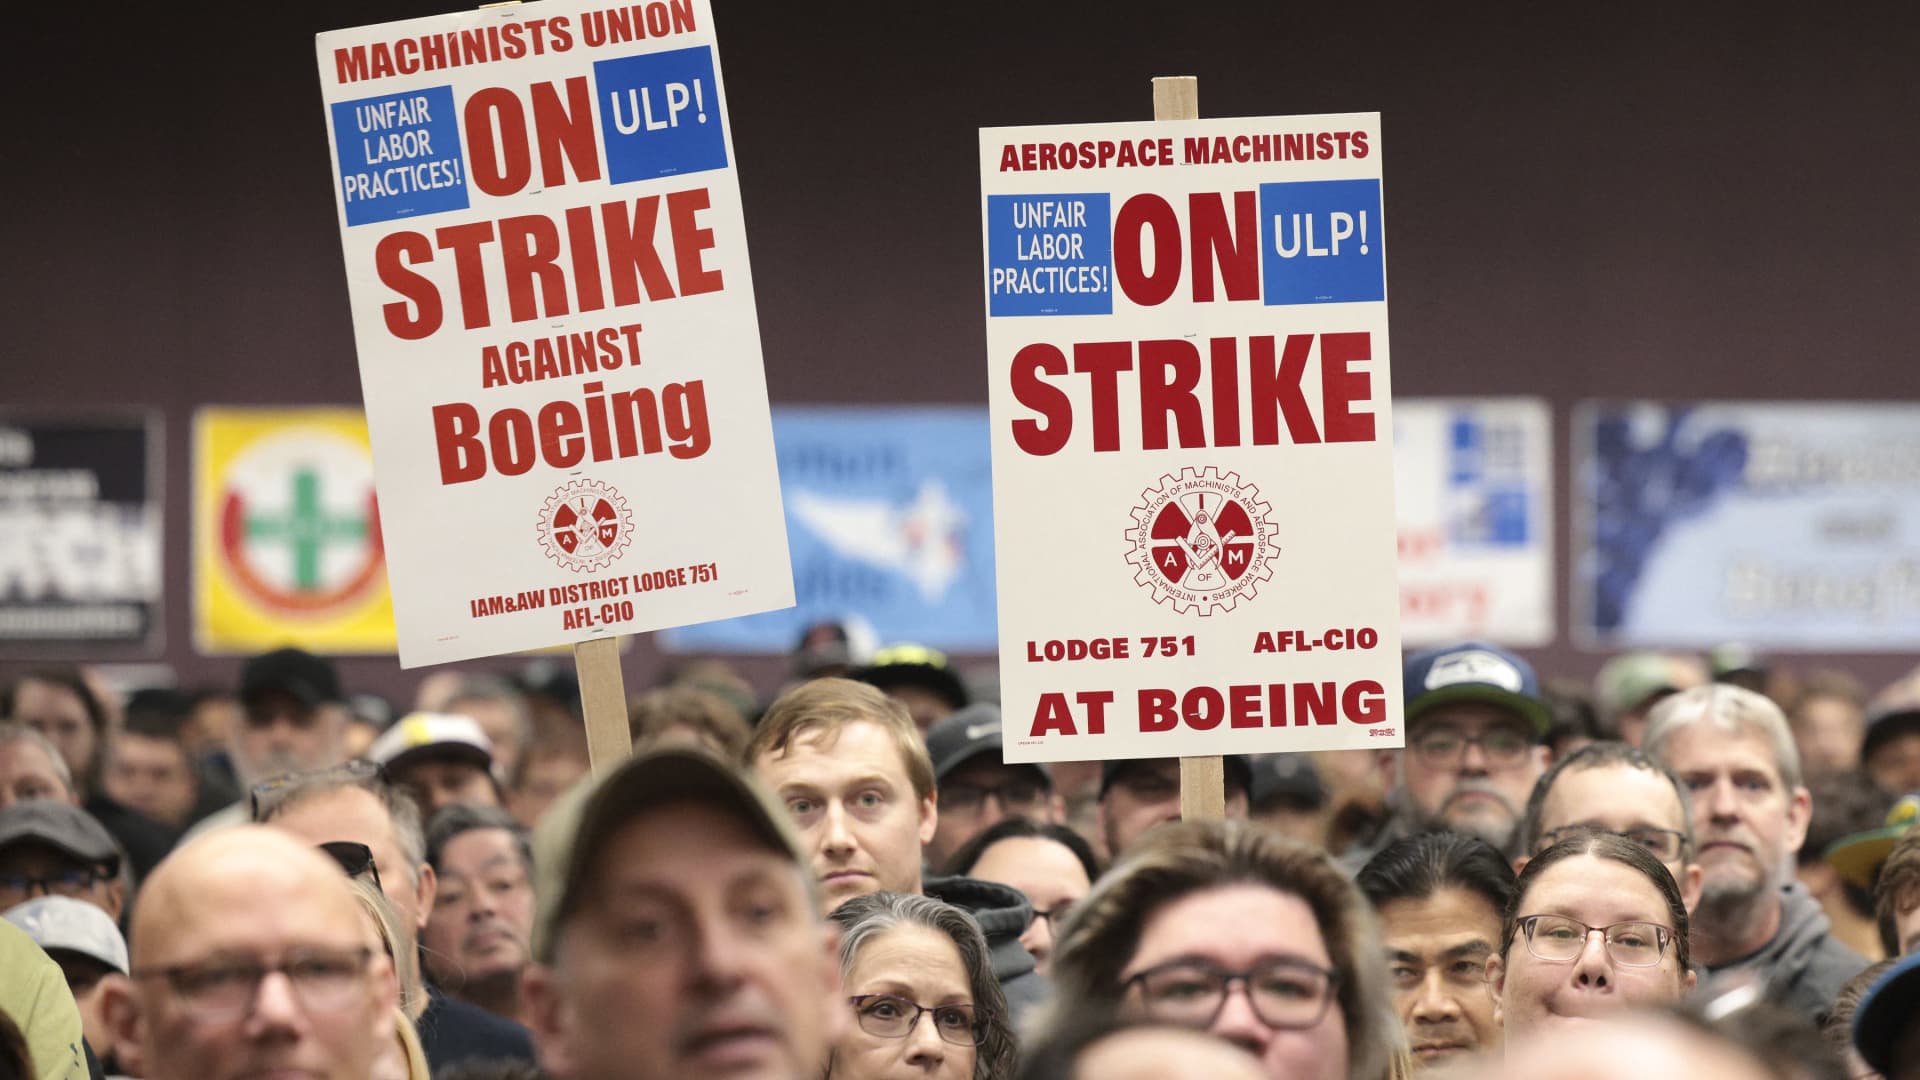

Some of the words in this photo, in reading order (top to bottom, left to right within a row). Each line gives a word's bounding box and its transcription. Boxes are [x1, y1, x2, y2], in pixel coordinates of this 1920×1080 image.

[335, 17, 573, 83] MACHINISTS
[582, 0, 695, 47] UNION
[356, 97, 432, 132] UNFAIR
[611, 79, 706, 134] ULP!
[364, 130, 433, 164] LABOR
[465, 76, 600, 196] ON
[1000, 139, 1173, 171] AEROSPACE
[1184, 131, 1368, 164] MACHINISTS
[343, 159, 461, 202] PRACTICES!
[1014, 201, 1086, 228] UNFAIR
[1275, 210, 1368, 258] ULP!
[376, 188, 723, 340] STRIKE
[1018, 233, 1084, 260] LABOR
[1114, 191, 1259, 306] ON
[993, 266, 1107, 294] PRACTICES!
[483, 324, 641, 388] AGAINST
[1011, 332, 1375, 456] STRIKE
[433, 380, 711, 485] Boeing
[1170, 485, 1182, 496] OF
[1185, 479, 1241, 499] MACHINISTS
[1240, 497, 1257, 514] AND
[563, 535, 572, 545] A
[602, 528, 613, 539] M
[1139, 492, 1170, 549] ASSOCIATION
[1164, 552, 1178, 567] A
[1228, 550, 1244, 566] M
[1253, 515, 1266, 572] AEROSPACE
[471, 590, 544, 617] IAM&AW
[550, 577, 627, 605] DISTRICT
[634, 568, 686, 592] LODGE
[691, 564, 717, 583] 751
[1140, 553, 1196, 602] INTERNATIONAL
[1197, 573, 1213, 582] OF
[1212, 572, 1255, 601] WORKERS
[564, 601, 633, 630] AFL-CIO
[1028, 638, 1129, 662] LODGE
[1141, 636, 1194, 657] 751
[1254, 628, 1377, 653] AFL-CIO
[1030, 691, 1113, 736] AT
[1138, 680, 1386, 732] BOEING
